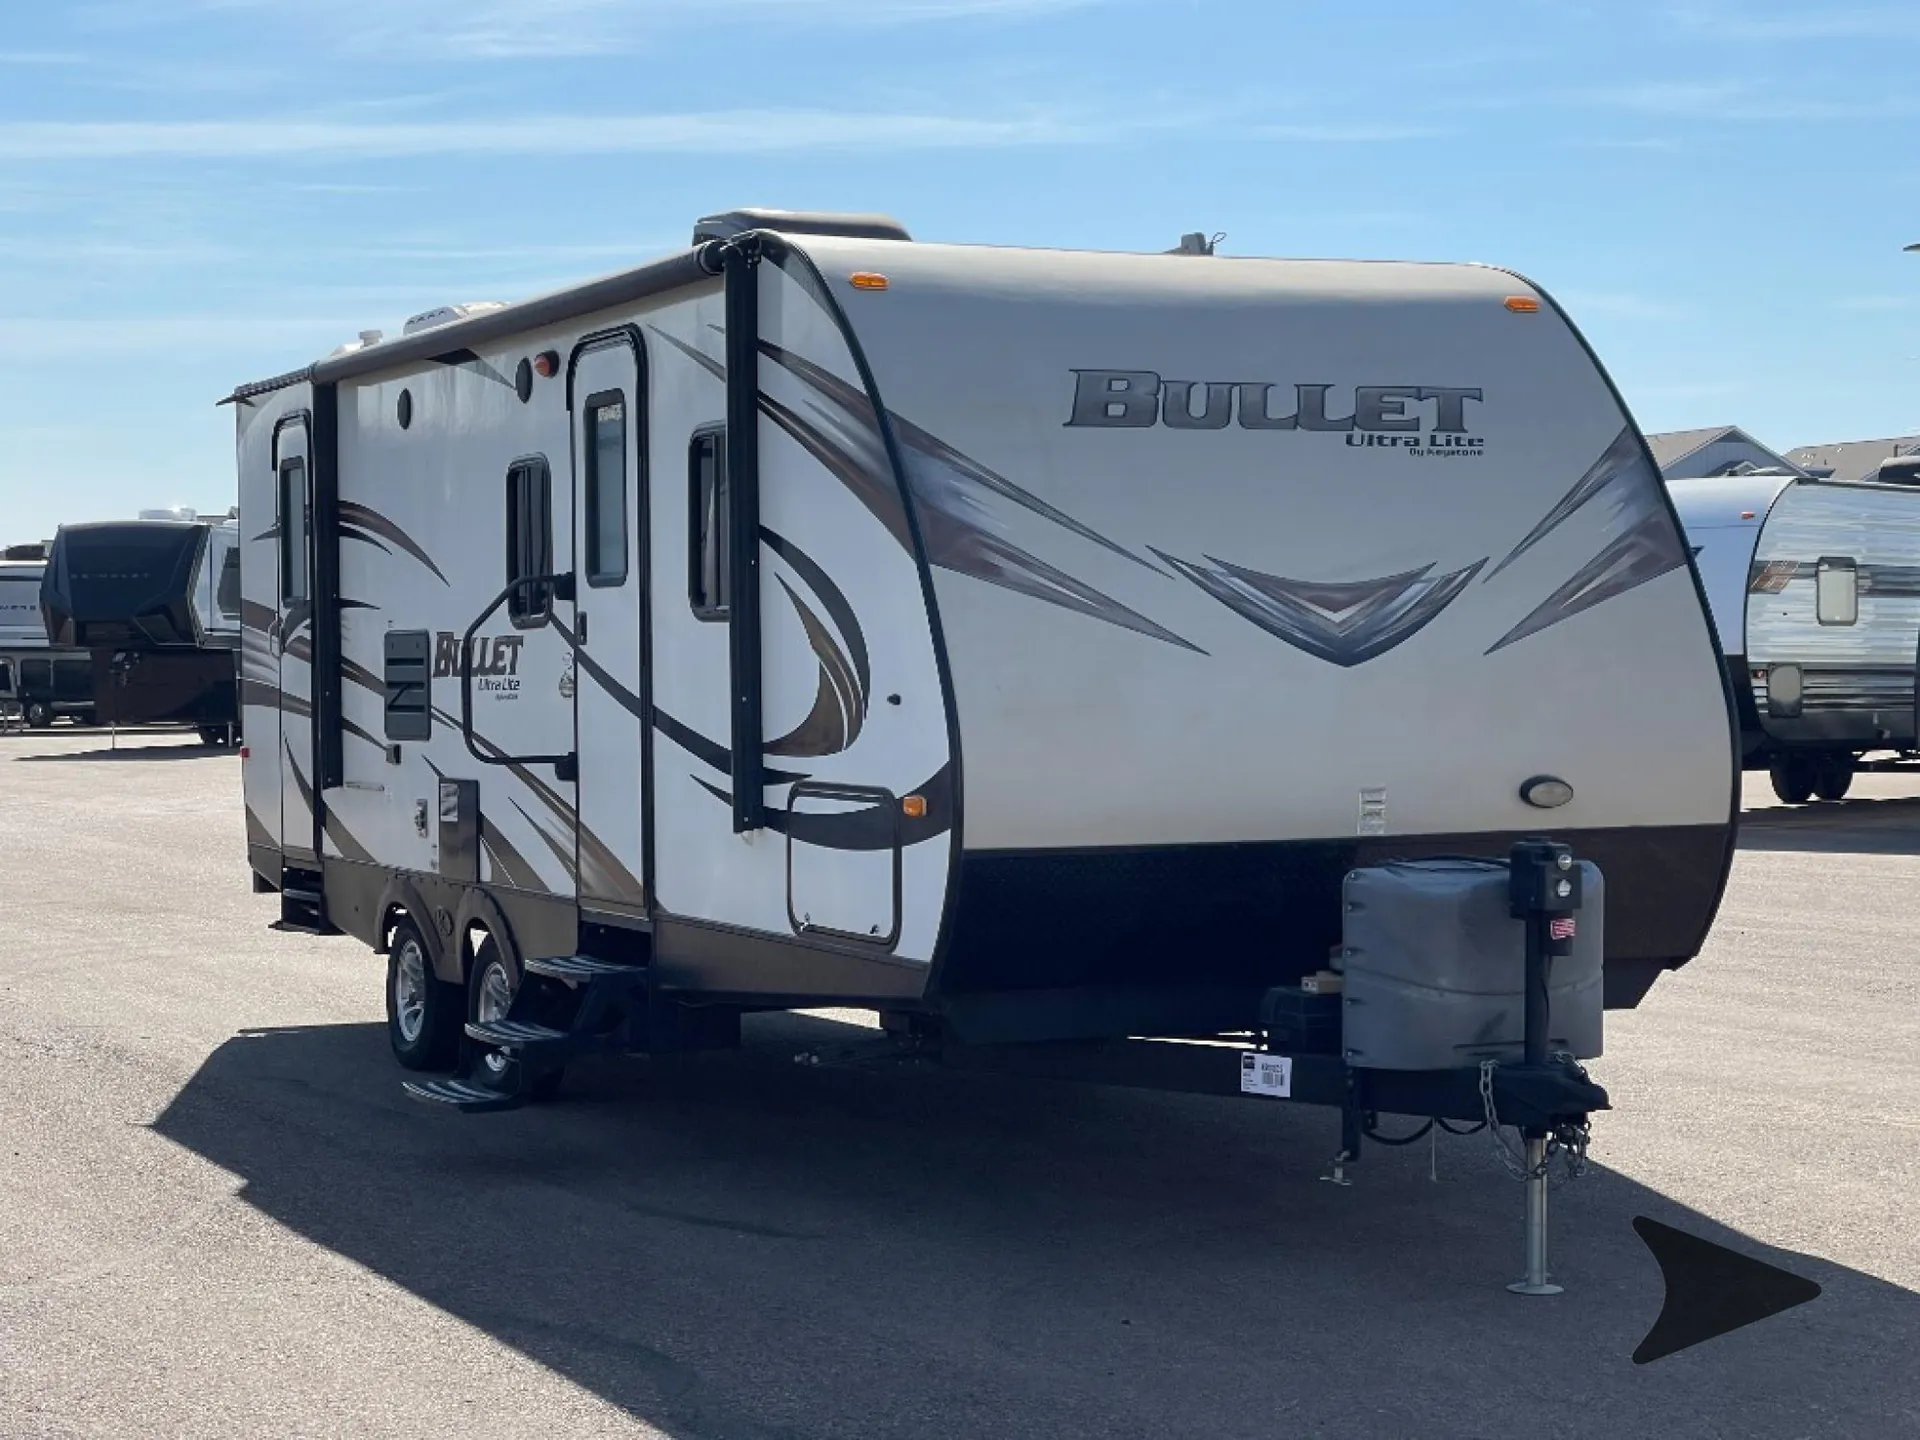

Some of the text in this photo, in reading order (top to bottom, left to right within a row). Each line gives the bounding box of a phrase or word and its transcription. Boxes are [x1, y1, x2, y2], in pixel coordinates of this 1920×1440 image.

[1063, 368, 1484, 433] BULLET
[1345, 433, 1484, 447] Ultra Lite
[1409, 447, 1484, 458] By Keystone
